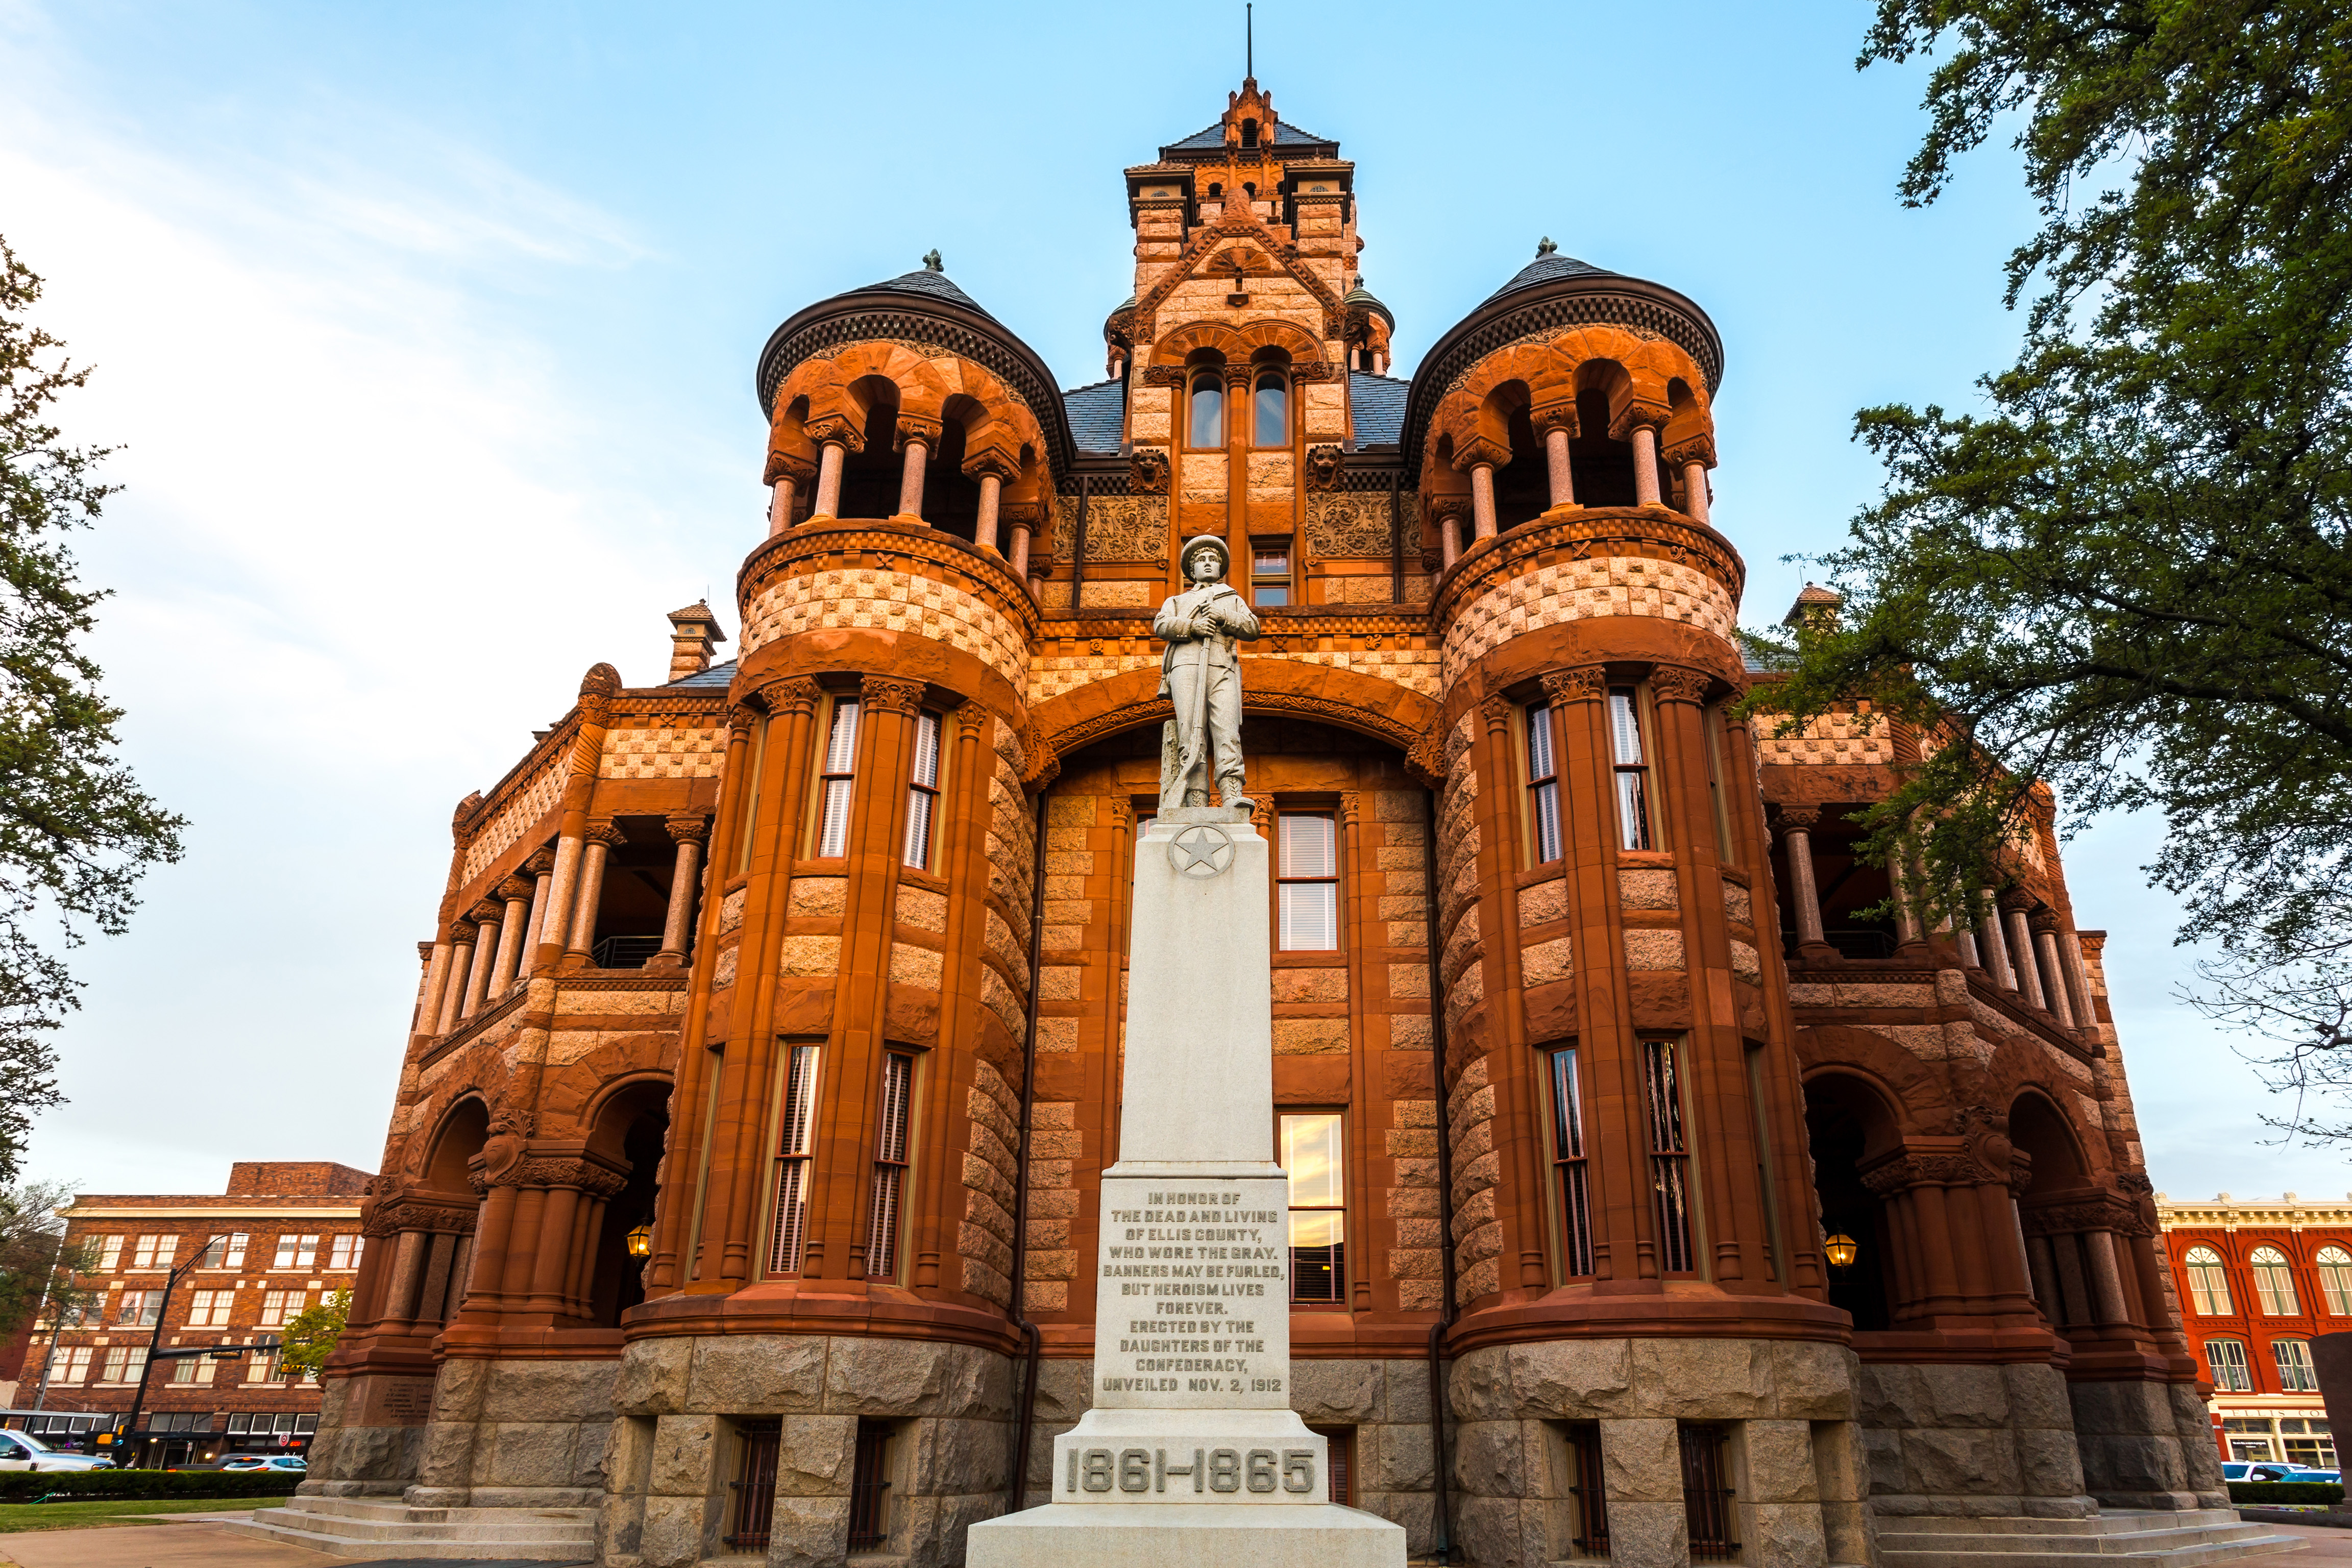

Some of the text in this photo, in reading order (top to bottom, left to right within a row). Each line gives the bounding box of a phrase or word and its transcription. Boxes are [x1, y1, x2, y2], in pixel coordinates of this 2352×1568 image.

[1148, 1192, 1240, 1205] IN HONOR OF
[1111, 1210, 1277, 1222] THE DEAD AND LIVING
[1125, 1229, 1262, 1243] OF ELLIS COUNTY,
[1109, 1246, 1278, 1259] WHO WORE THE GRAY.
[1104, 1265, 1285, 1280] BANNERS MAY BE FURLED,
[1122, 1283, 1264, 1295] BUT HEROISM LIVES
[1157, 1302, 1228, 1314] FOREVER.
[1130, 1320, 1254, 1333] ERECTED BY THE
[1120, 1339, 1264, 1352] DAUGHTERS OF THE
[1136, 1359, 1248, 1374] CONFEDERACY,
[1102, 1378, 1281, 1393] UNVEILED NOV. 2, 1912
[1067, 1448, 1314, 1492] 1861-1865
